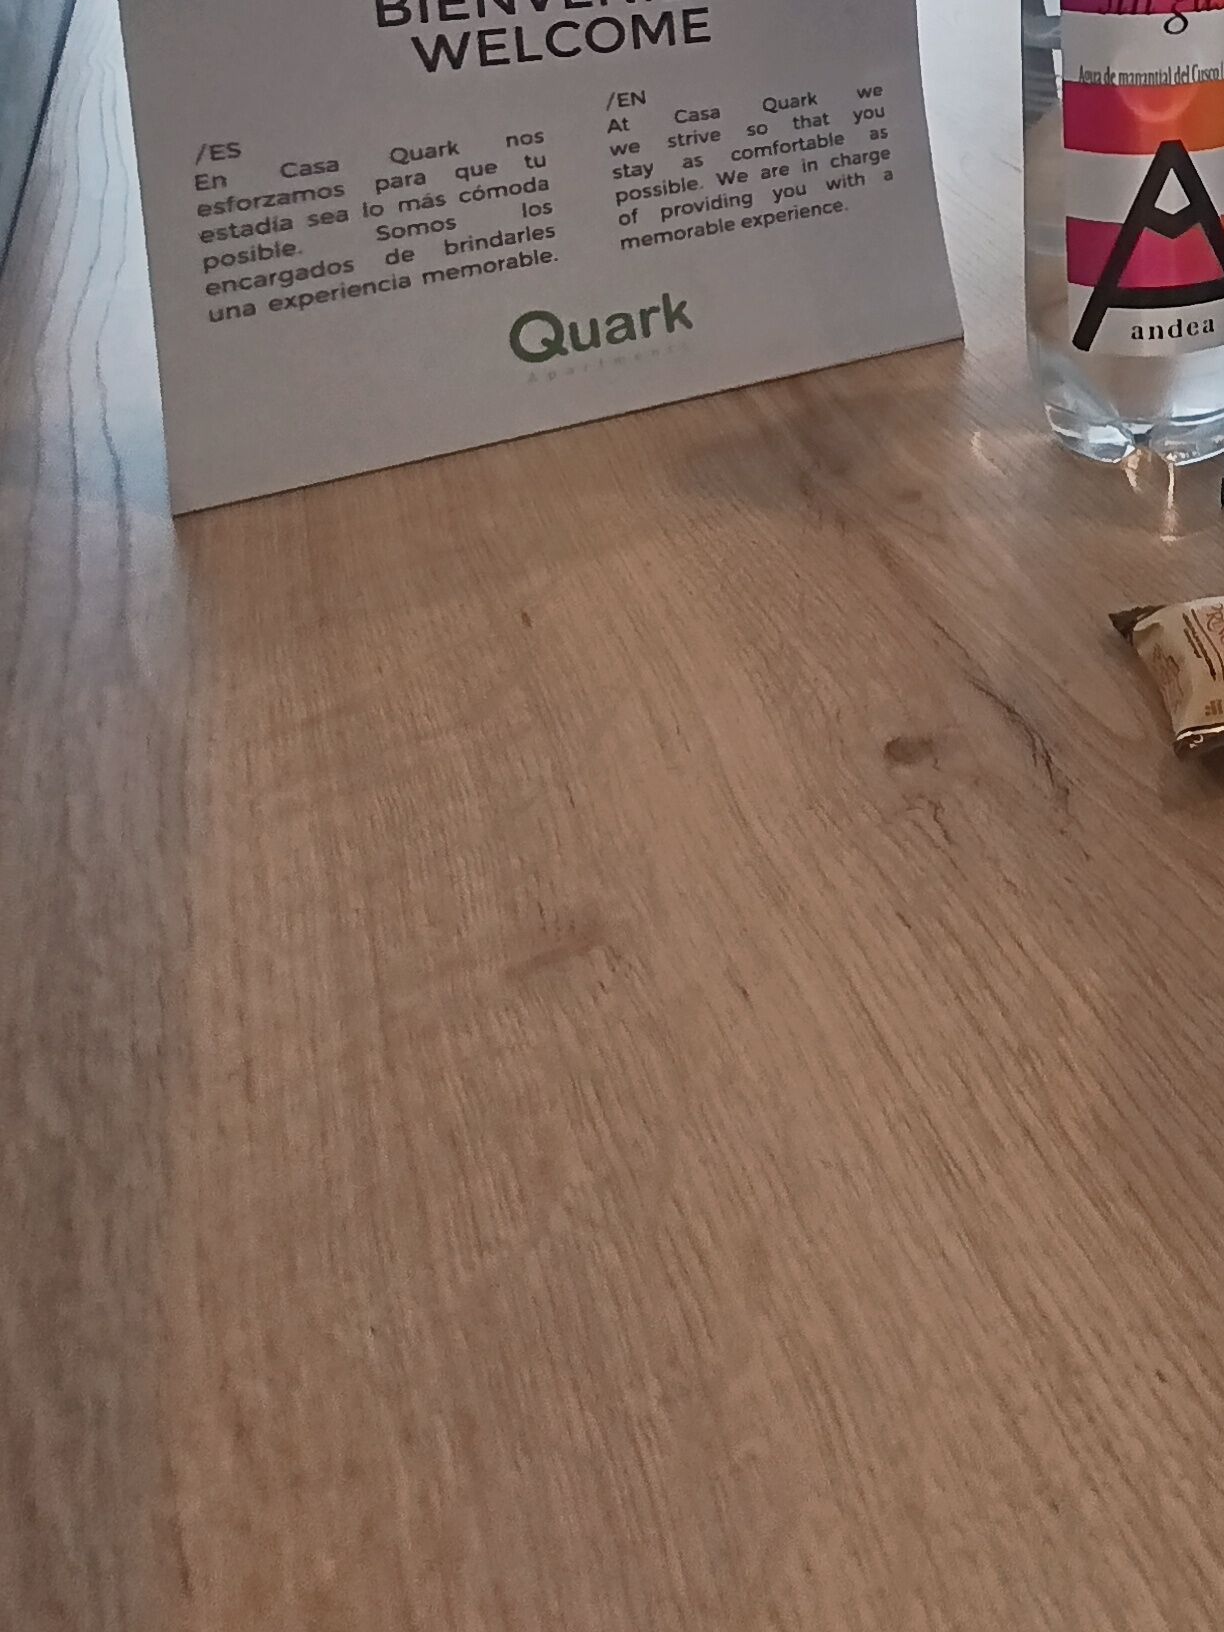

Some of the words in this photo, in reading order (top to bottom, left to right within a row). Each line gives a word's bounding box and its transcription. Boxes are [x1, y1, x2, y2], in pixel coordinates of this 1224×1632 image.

[410, 6, 712, 73] WELCOME
[606, 90, 646, 111] /EN
[607, 117, 630, 134] At
[674, 106, 720, 124] Casa
[762, 91, 818, 113] Quark
[857, 85, 883, 100] we
[610, 141, 640, 156] we
[667, 129, 721, 148] strive
[747, 122, 768, 137] so
[792, 112, 830, 130] that
[853, 105, 885, 125] you
[195, 142, 242, 166] /ES
[195, 174, 228, 191] En
[280, 159, 340, 179] Casa
[389, 141, 460, 164] Quark
[505, 131, 545, 148] nos
[612, 161, 654, 180] stay
[682, 154, 704, 170] as
[730, 132, 845, 162] comfortable
[869, 126, 888, 141] as
[615, 178, 704, 207] possible.
[716, 169, 749, 186] We
[760, 163, 790, 180] are
[801, 158, 818, 173] in
[830, 147, 891, 170] charge
[197, 184, 346, 217] esforzamos
[375, 172, 427, 195] para
[455, 161, 498, 182] que
[524, 154, 547, 170] tu
[199, 215, 293, 244] estadía
[308, 209, 350, 228] sea
[362, 201, 385, 218] lo
[398, 193, 447, 213] más
[459, 178, 550, 204] cómoda
[618, 208, 638, 226] of
[660, 192, 753, 222] providing
[772, 183, 807, 203] you
[826, 174, 866, 191] with
[883, 168, 894, 182] a
[203, 242, 302, 274] posible.
[376, 218, 457, 241] Somos
[522, 201, 553, 218] los
[620, 217, 736, 250] memorable
[741, 198, 848, 229] experience.
[205, 258, 355, 296] encargados
[385, 248, 415, 267] de
[444, 224, 556, 257] brindarles
[208, 302, 257, 323] una
[268, 274, 412, 312] experiencia
[422, 249, 559, 285] memorable.
[509, 292, 693, 363] Quark
[1131, 318, 1216, 340] andea
